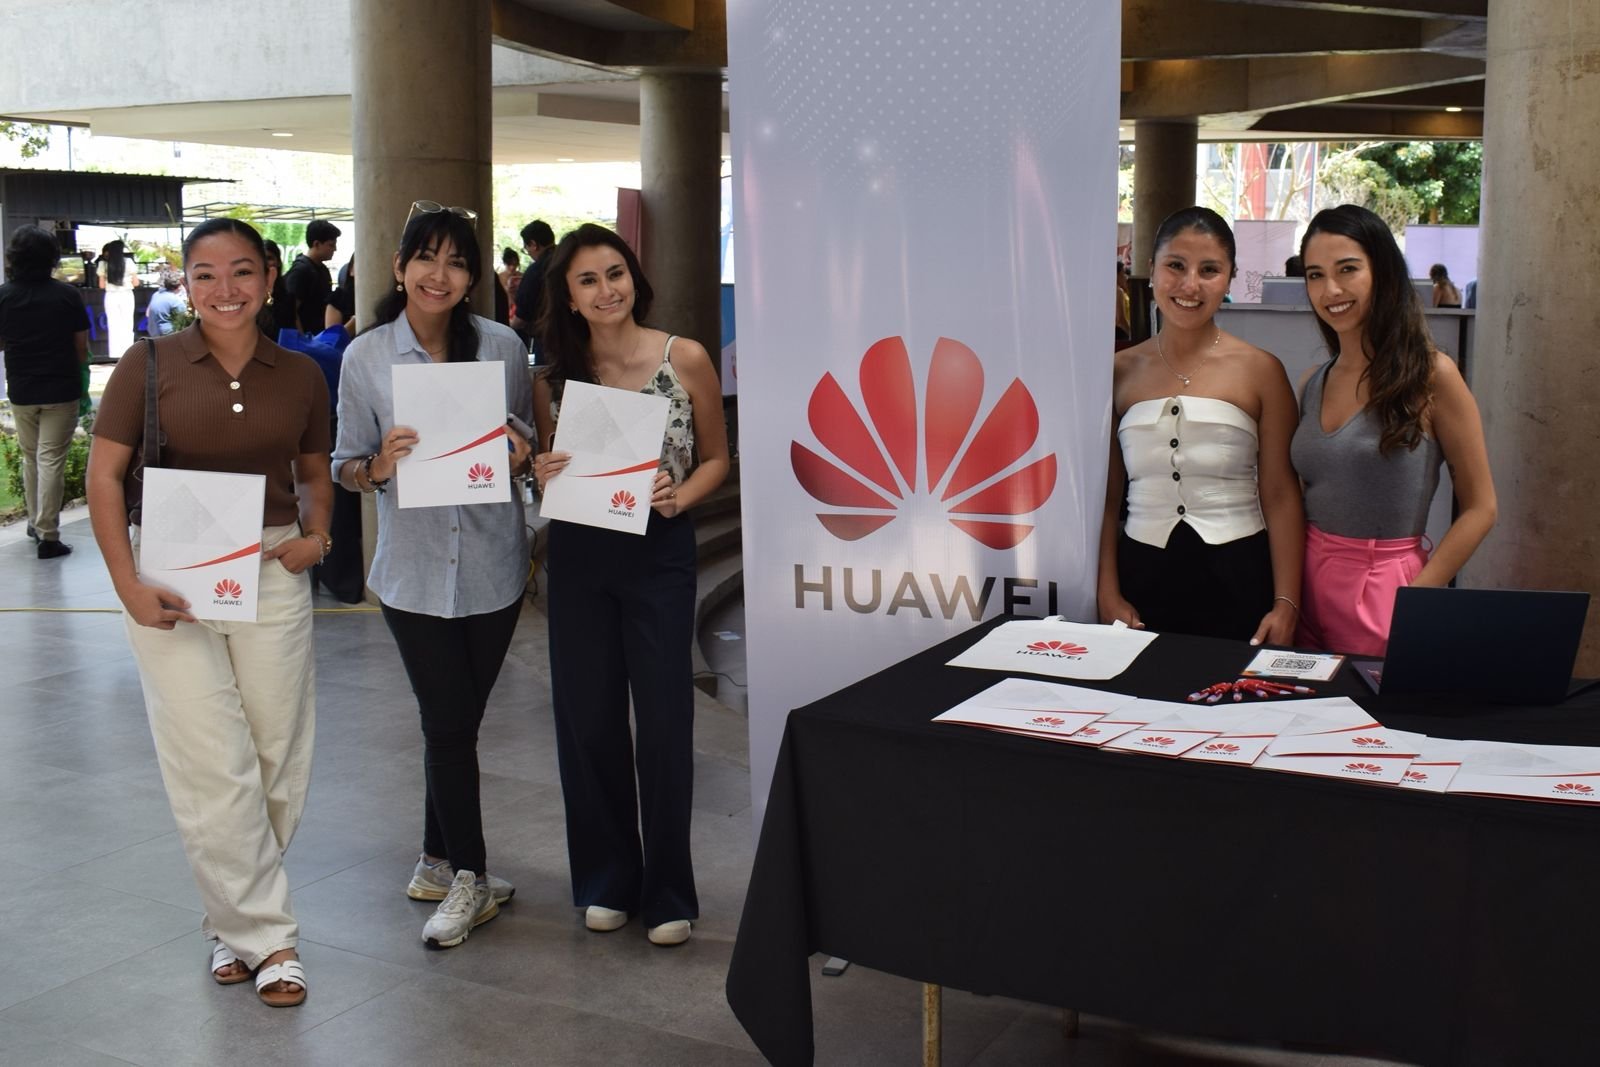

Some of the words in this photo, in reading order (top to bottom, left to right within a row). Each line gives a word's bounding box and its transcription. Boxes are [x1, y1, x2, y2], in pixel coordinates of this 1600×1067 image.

[608, 509, 634, 517] HUAWEI
[794, 563, 1058, 622] HUAWEI
[1016, 650, 1082, 661] HUAWEI
